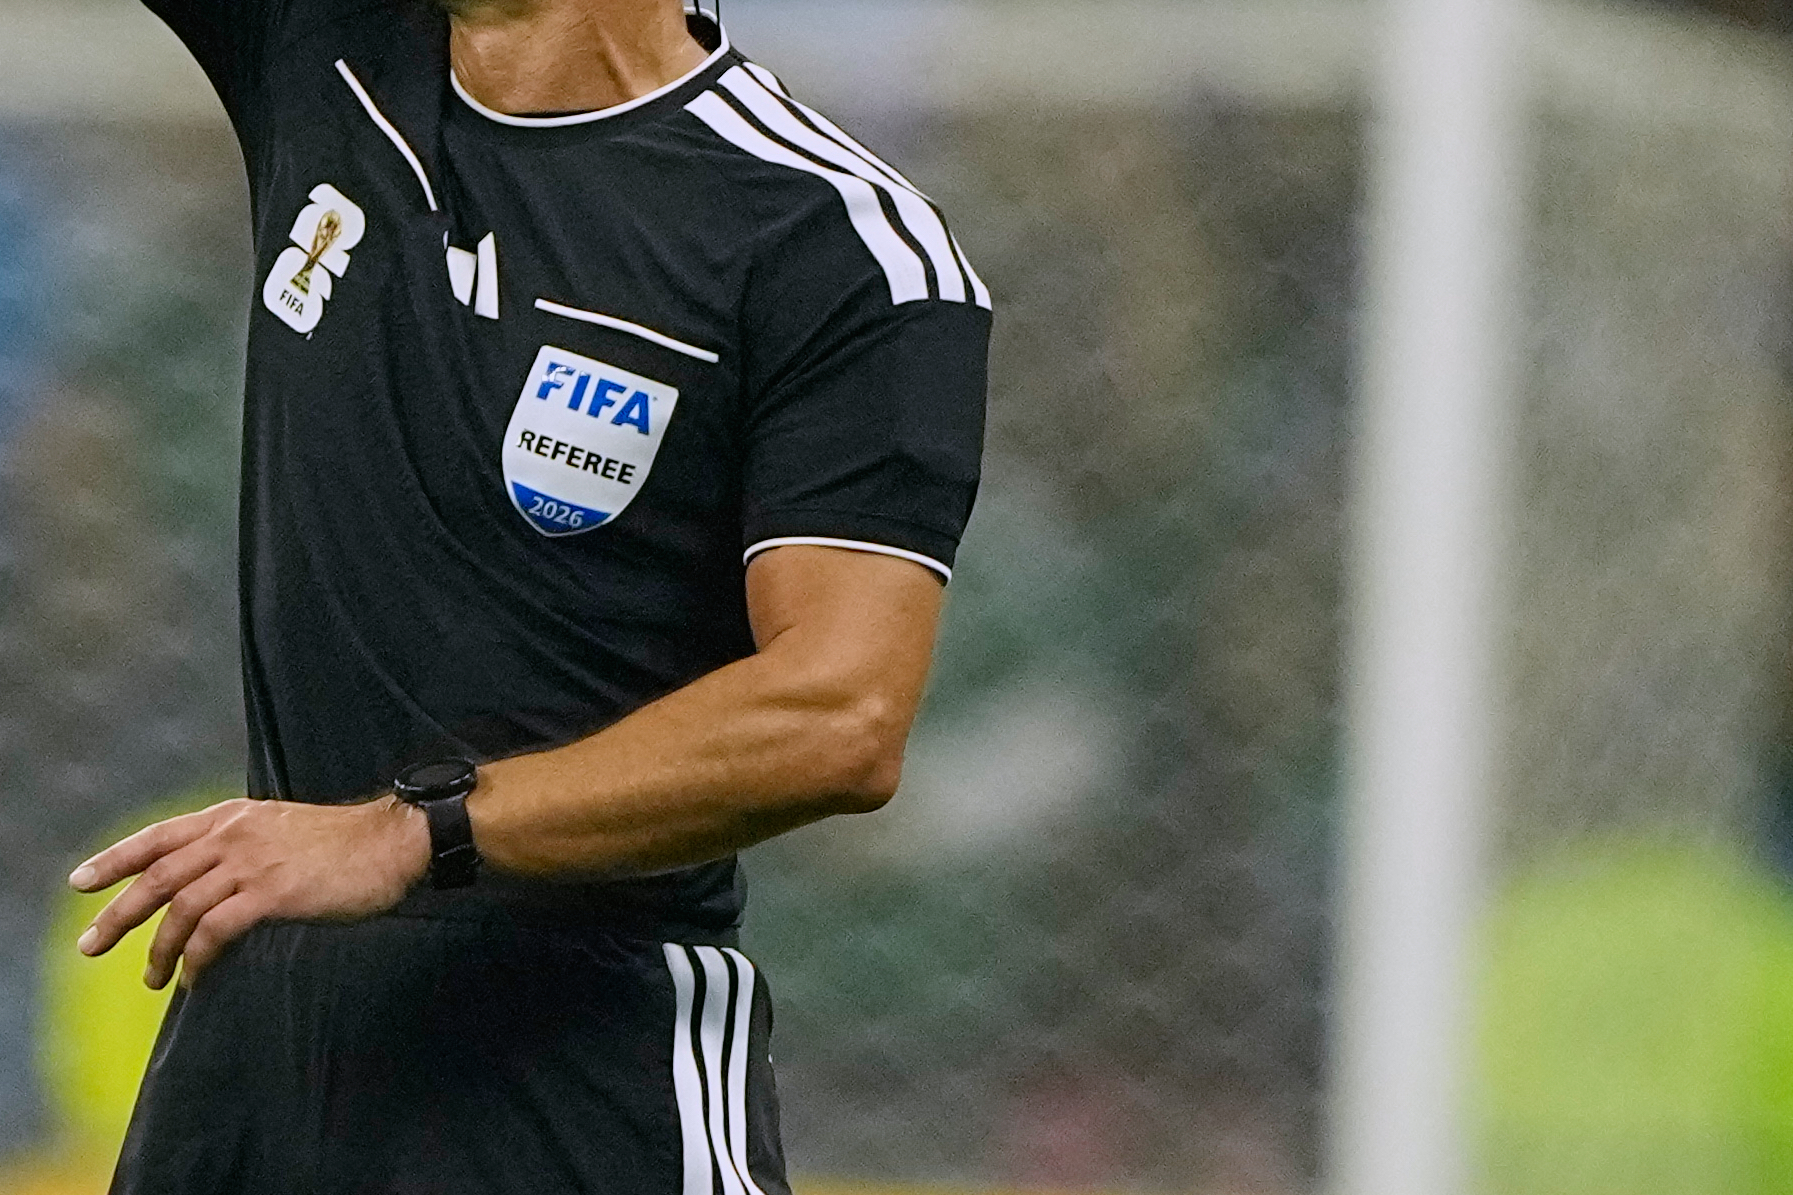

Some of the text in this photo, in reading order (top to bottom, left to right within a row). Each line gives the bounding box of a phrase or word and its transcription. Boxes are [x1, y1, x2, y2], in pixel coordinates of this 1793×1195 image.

[279, 289, 304, 317] FIFA
[536, 362, 649, 435] FIFA
[516, 430, 636, 484] REFEREE
[528, 496, 584, 528] 2026
